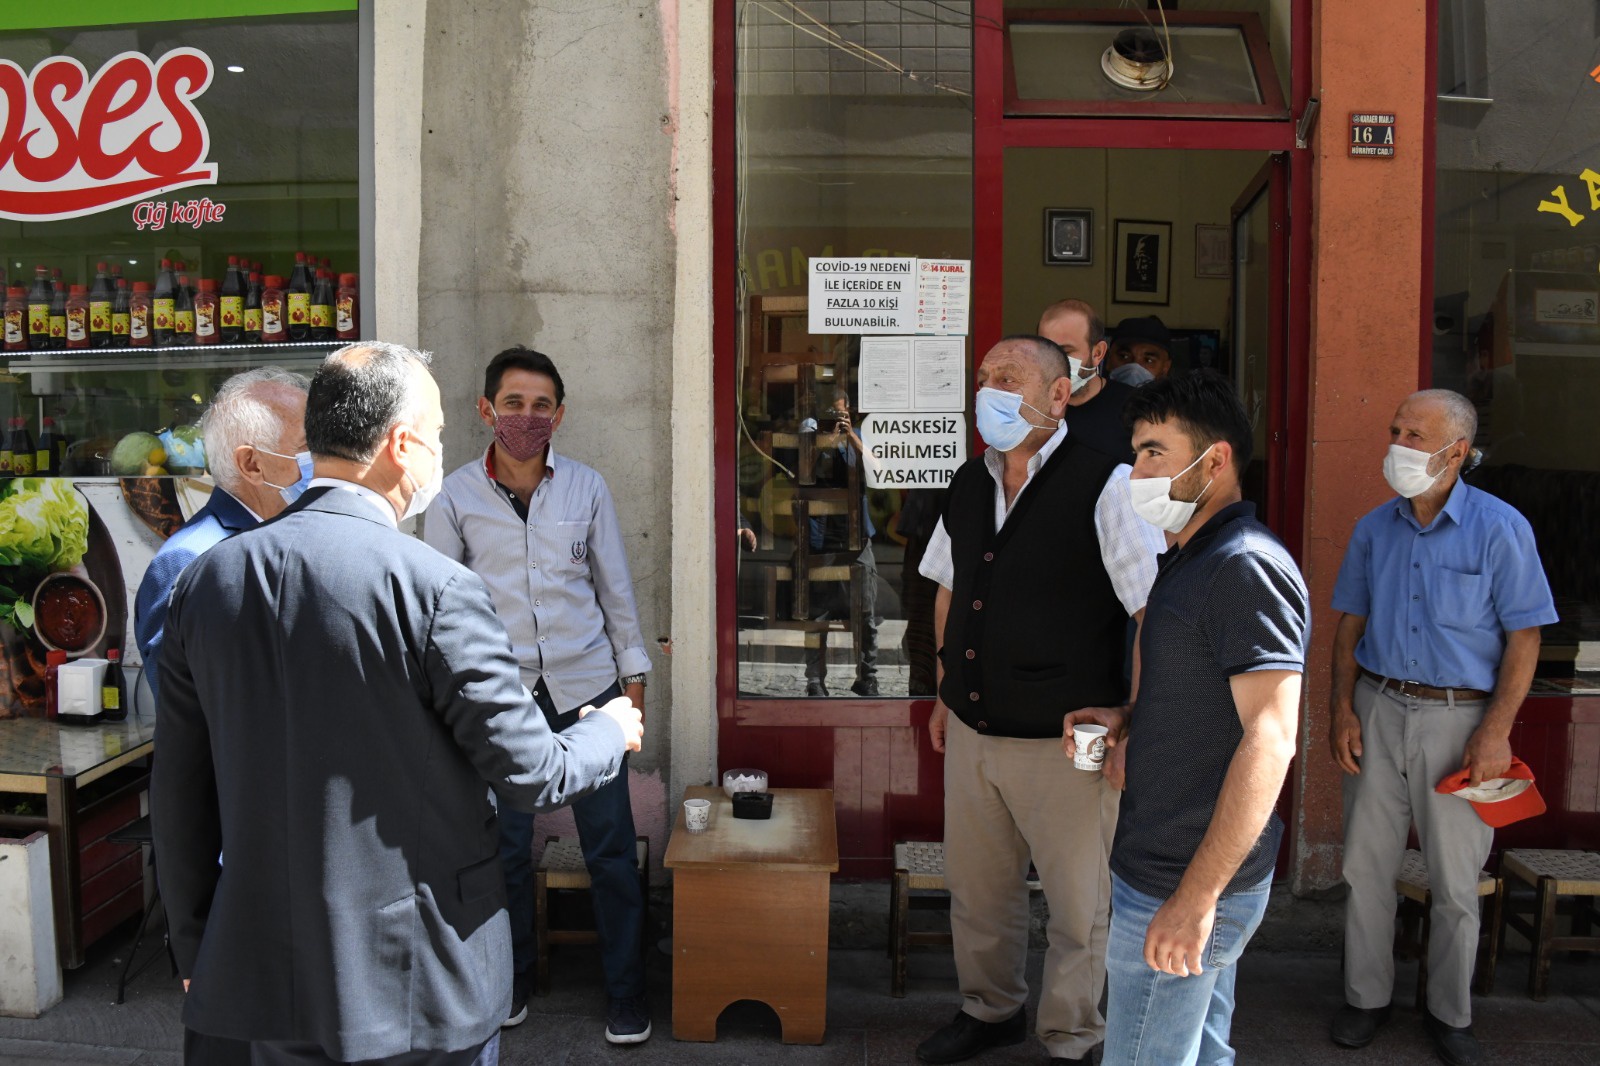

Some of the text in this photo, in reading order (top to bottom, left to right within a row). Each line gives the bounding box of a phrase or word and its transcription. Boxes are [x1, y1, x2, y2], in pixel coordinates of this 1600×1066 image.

[1353, 126, 1393, 144] 16 A
[170, 198, 226, 229] köfte
[815, 261, 911, 272] COVİD-19 NEDENİ
[940, 265, 965, 273] KURAL
[824, 279, 901, 291] İLE İÇERİDE EN
[827, 297, 898, 309] FAZLA 10 KİŞİ
[825, 316, 900, 327] BULUNABİLİR.
[872, 416, 957, 434] MASKESİZ
[871, 441, 957, 459] GİRİLMESİ
[872, 469, 955, 484] YASAKTIR
